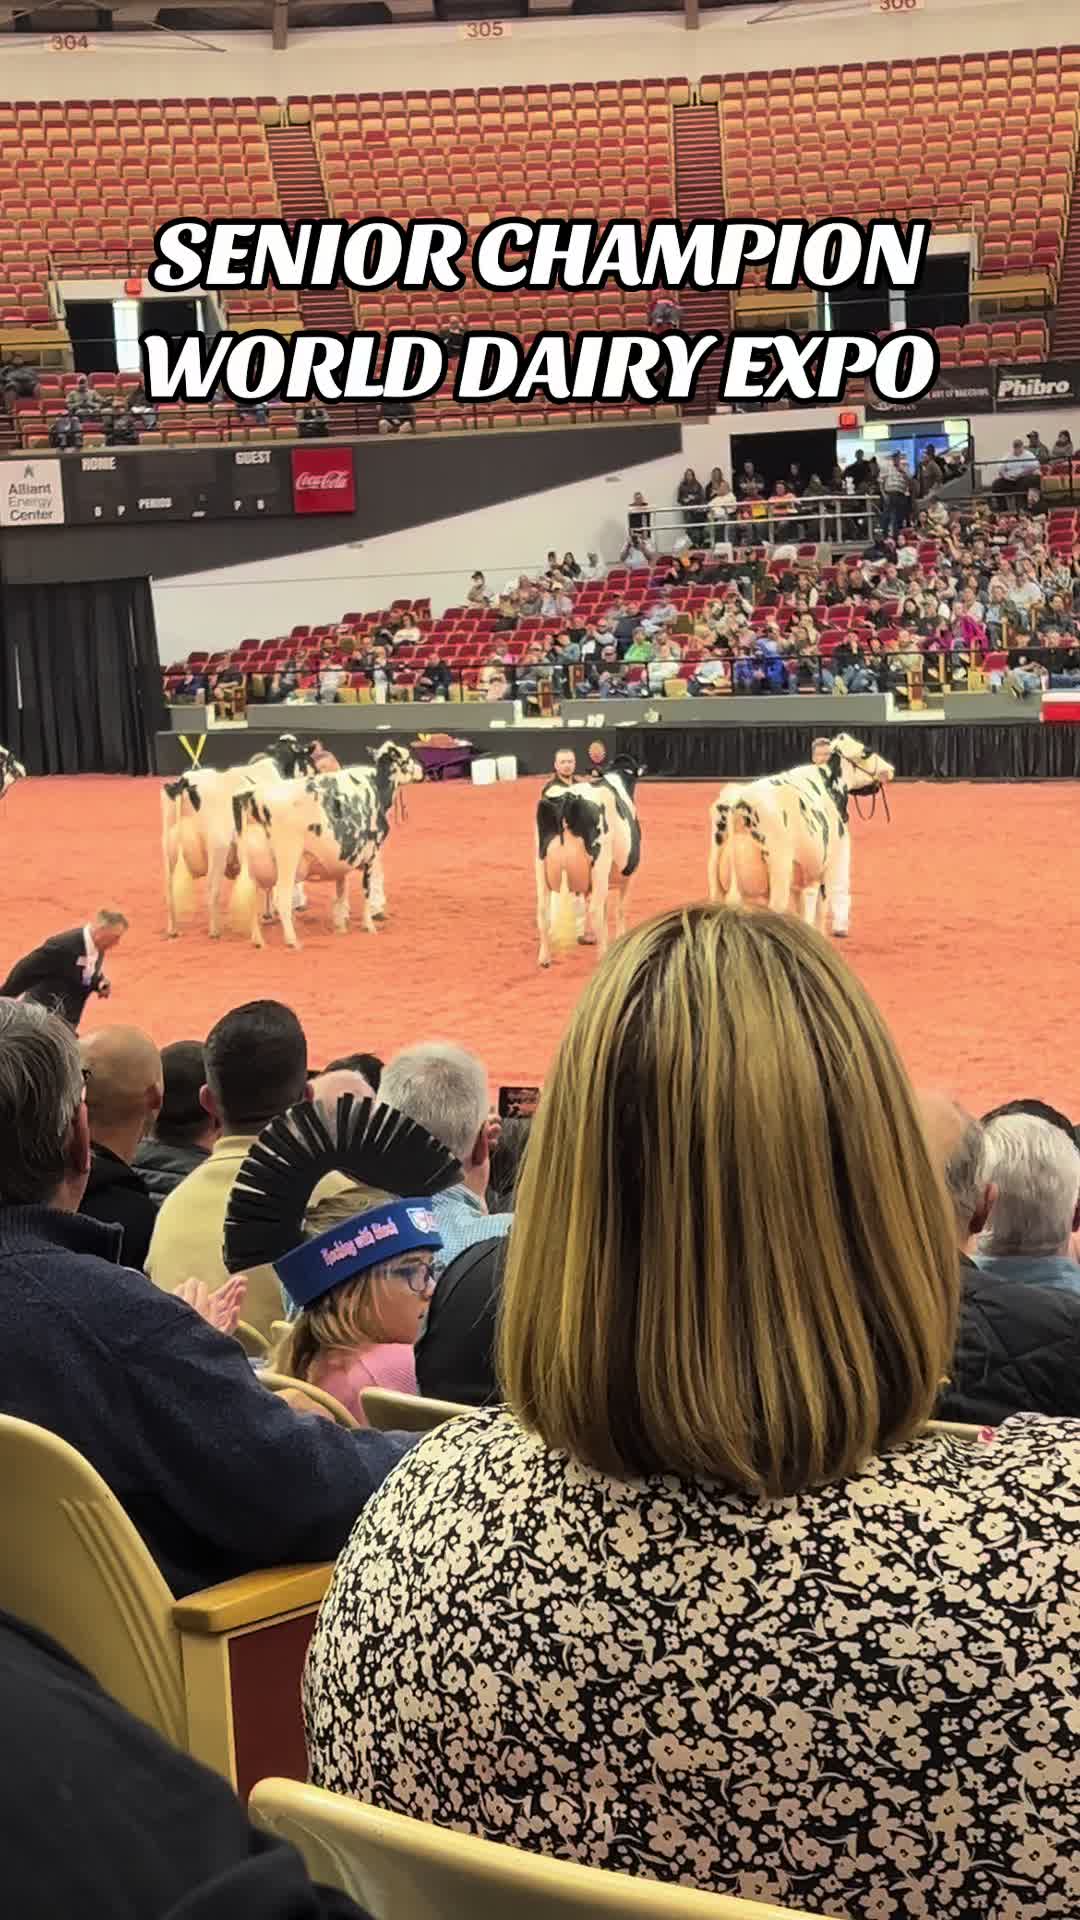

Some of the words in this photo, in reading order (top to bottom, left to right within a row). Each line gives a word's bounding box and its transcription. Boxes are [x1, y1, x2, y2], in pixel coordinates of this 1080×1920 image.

[467, 21, 503, 38] 305
[52, 34, 88, 50] 304
[998, 379, 1070, 396] Phibro
[81, 457, 116, 471] HOME
[235, 451, 271, 464] GUEST
[295, 470, 348, 490] Coca-Cola
[8, 483, 51, 495] Alliant
[8, 496, 52, 508] Energy
[10, 509, 53, 521] Center
